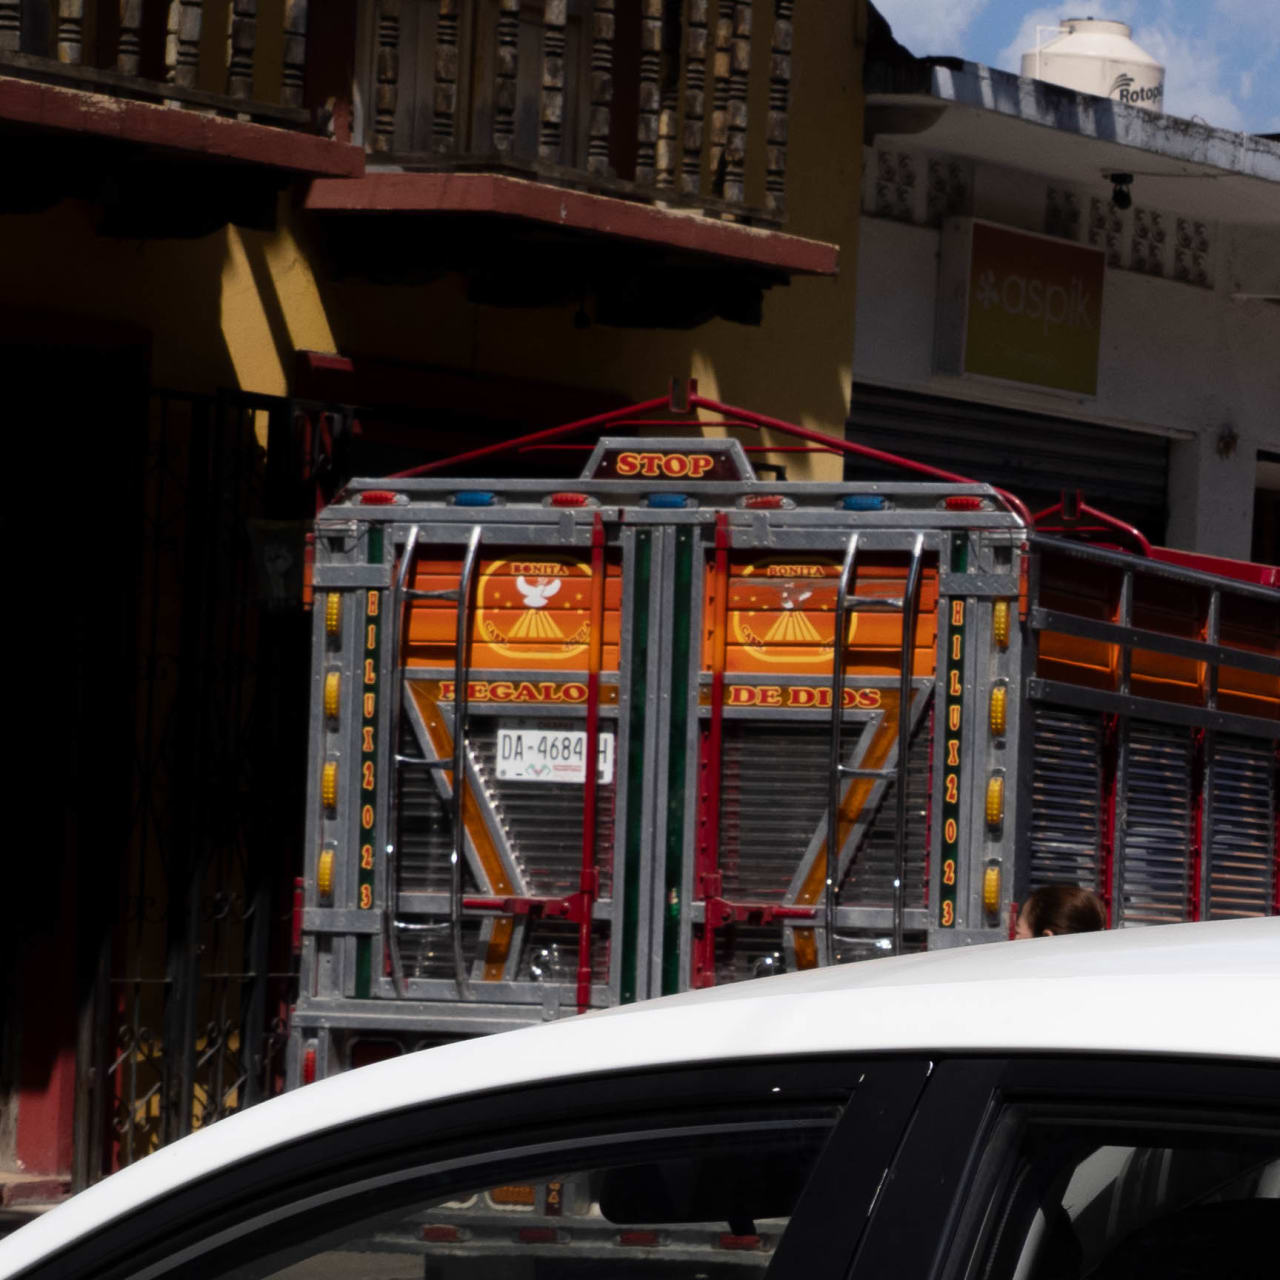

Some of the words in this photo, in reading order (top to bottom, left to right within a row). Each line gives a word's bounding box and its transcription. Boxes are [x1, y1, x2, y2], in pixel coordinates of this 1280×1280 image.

[1120, 83, 1165, 104] Rotop
[617, 452, 714, 477] STOP
[510, 561, 570, 576] BONITA
[766, 565, 826, 577] BONITA
[729, 686, 782, 706] DE
